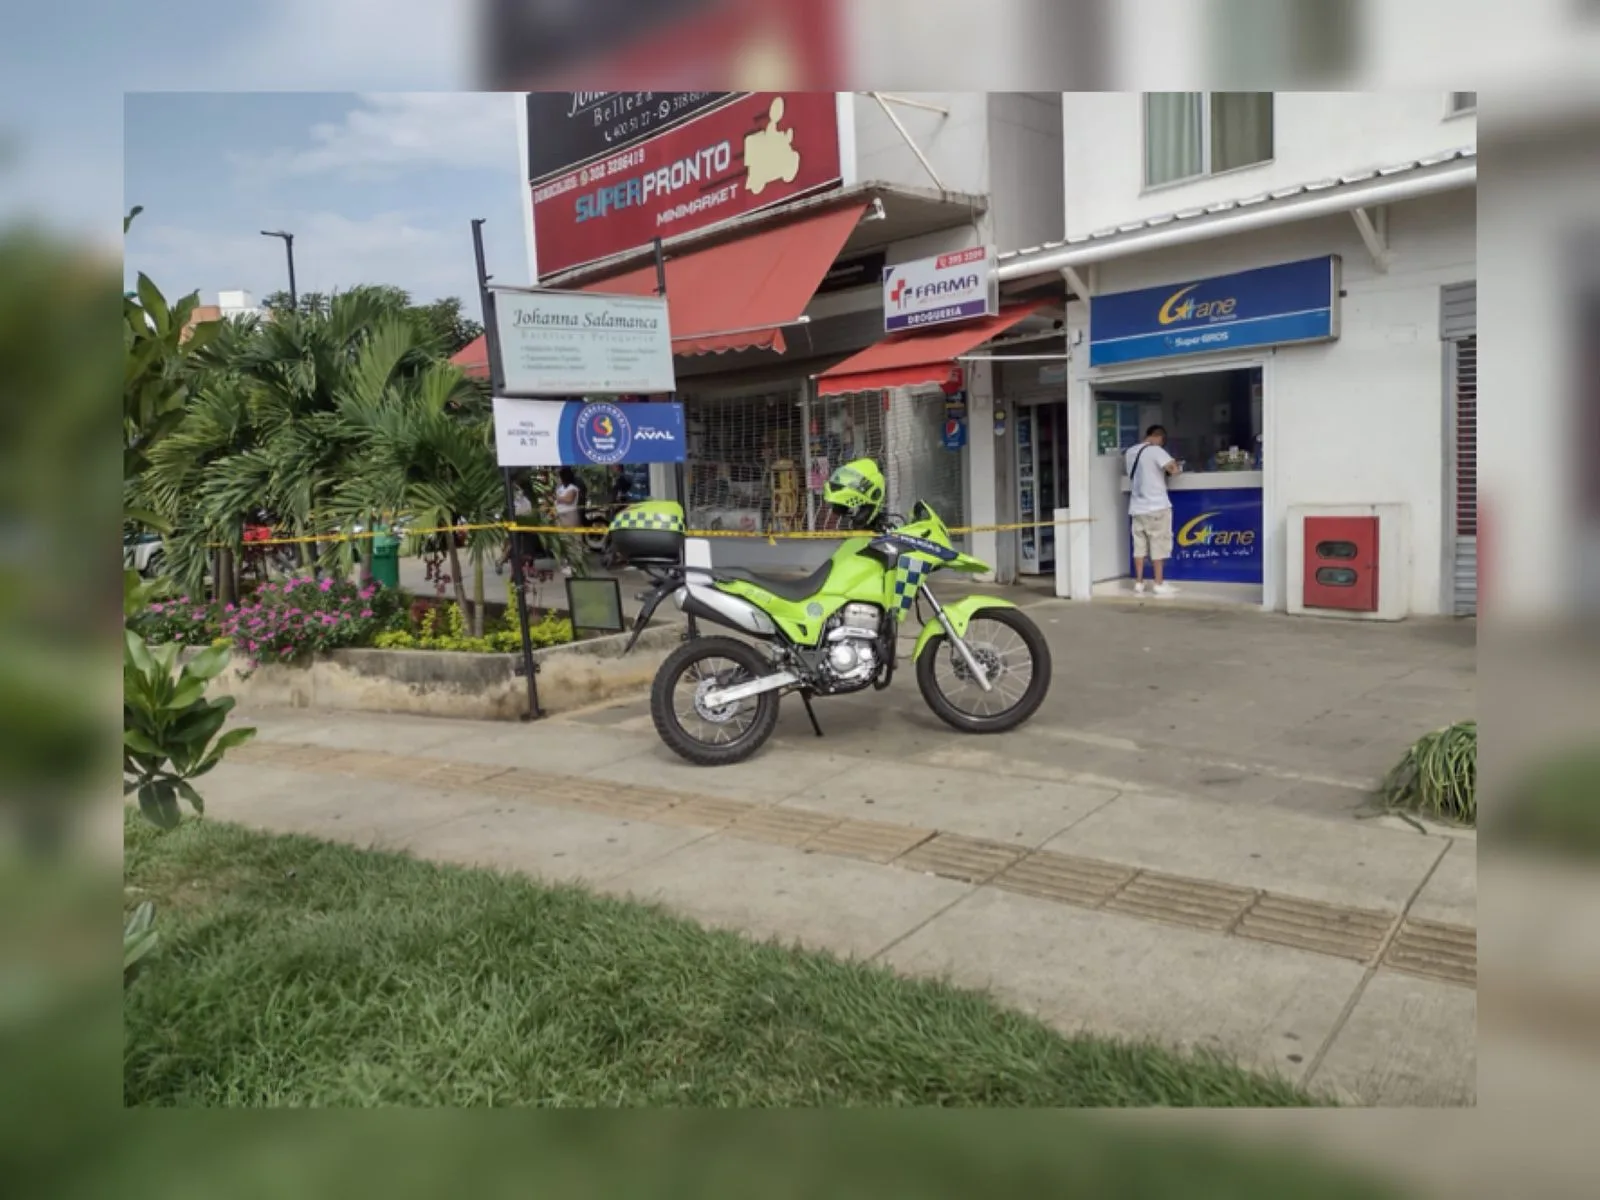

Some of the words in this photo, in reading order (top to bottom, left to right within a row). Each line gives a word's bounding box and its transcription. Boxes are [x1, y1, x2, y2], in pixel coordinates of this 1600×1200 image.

[656, 183, 739, 227] MINIMARKET
[915, 274, 979, 299] FARMA
[513, 307, 580, 328] Johanna
[582, 310, 658, 330] Salamanca
[633, 430, 676, 441] AVAL
